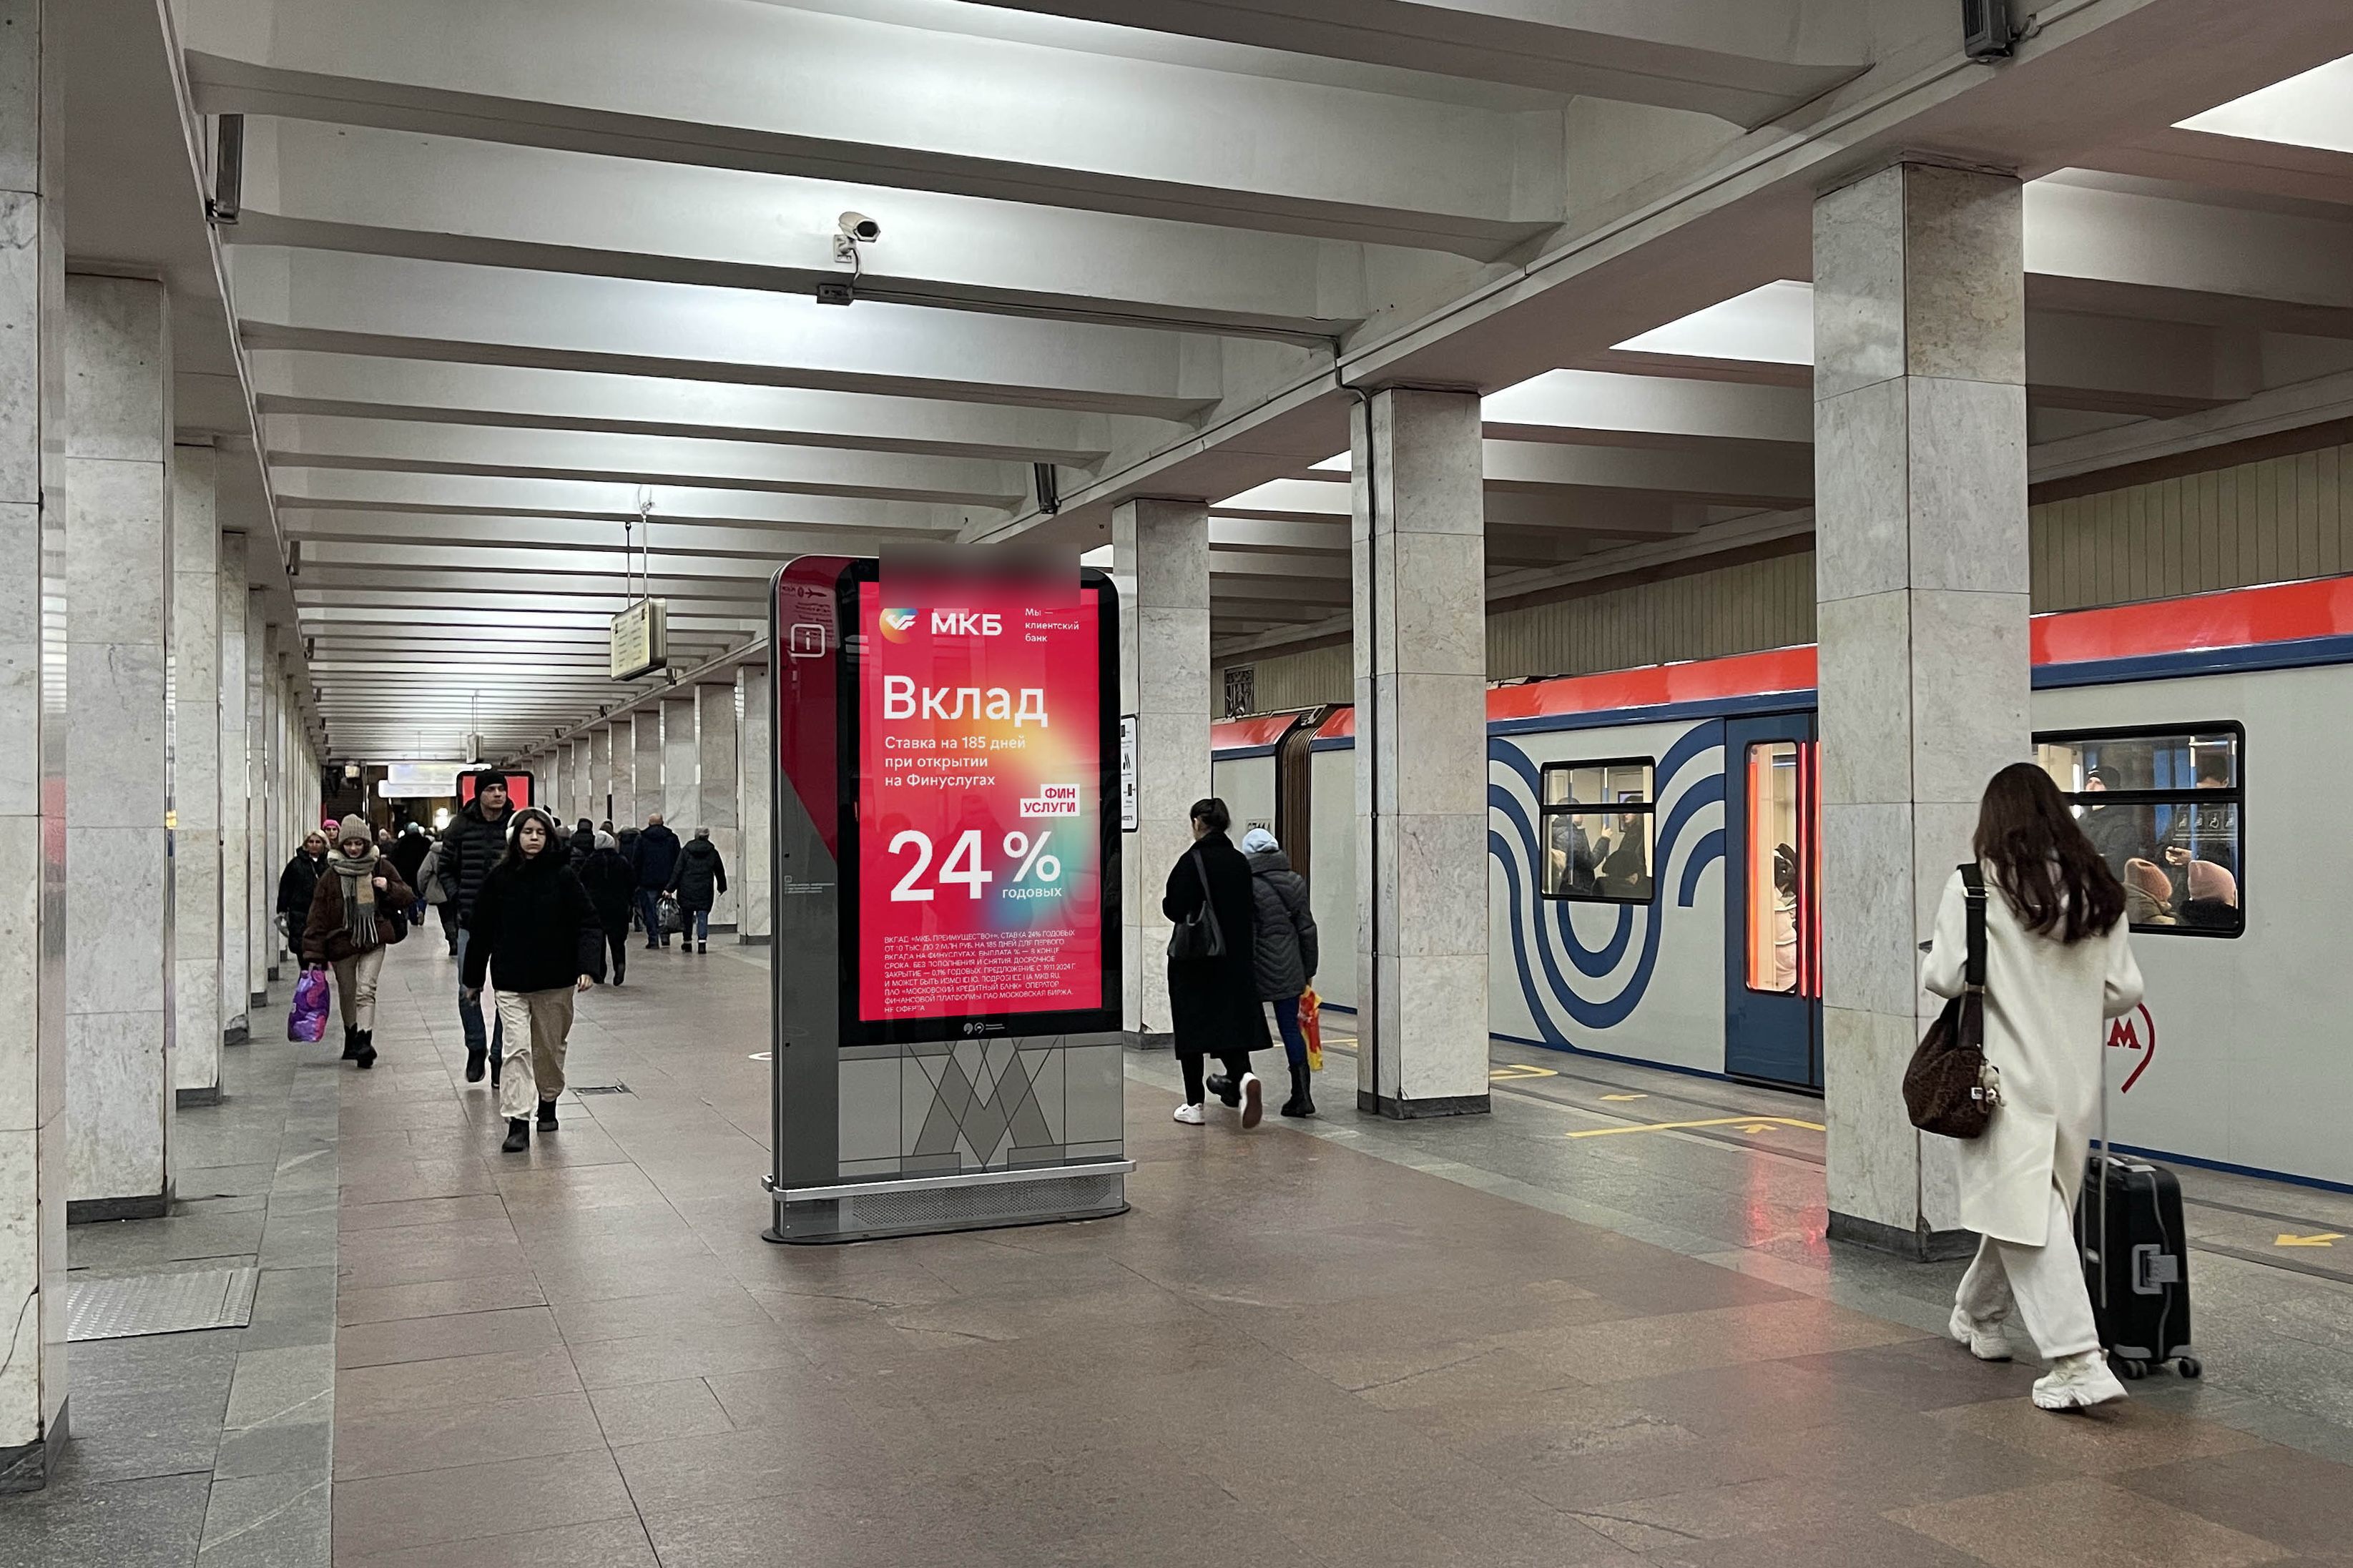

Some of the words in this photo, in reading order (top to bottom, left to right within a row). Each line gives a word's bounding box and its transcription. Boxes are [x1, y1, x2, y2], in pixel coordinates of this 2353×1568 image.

[1025, 608, 1041, 616] Мы
[931, 613, 1002, 636] МКБ
[1025, 621, 1079, 631] клиентский
[1025, 633, 1048, 642] банк
[883, 675, 1048, 728] Вклад
[885, 736, 936, 749] Ставка
[941, 739, 958, 749] на
[962, 736, 986, 749] 185
[990, 735, 1026, 751] дней
[885, 757, 913, 771] при
[917, 756, 988, 771] открытии
[885, 776, 902, 787] на
[906, 773, 995, 789] Финуслугах
[1045, 787, 1076, 799] ФИН
[1023, 802, 1076, 813] УСЛУГИ
[1002, 887, 1062, 899] годовых
[998, 939, 1017, 948] ДНЕЙ
[1013, 955, 1056, 965] ДОСРОЧНОЕ
[884, 970, 922, 978] ЗАКРЫТИЕ
[983, 965, 1035, 974] ПРЕДЛОЖЕНИЕ
